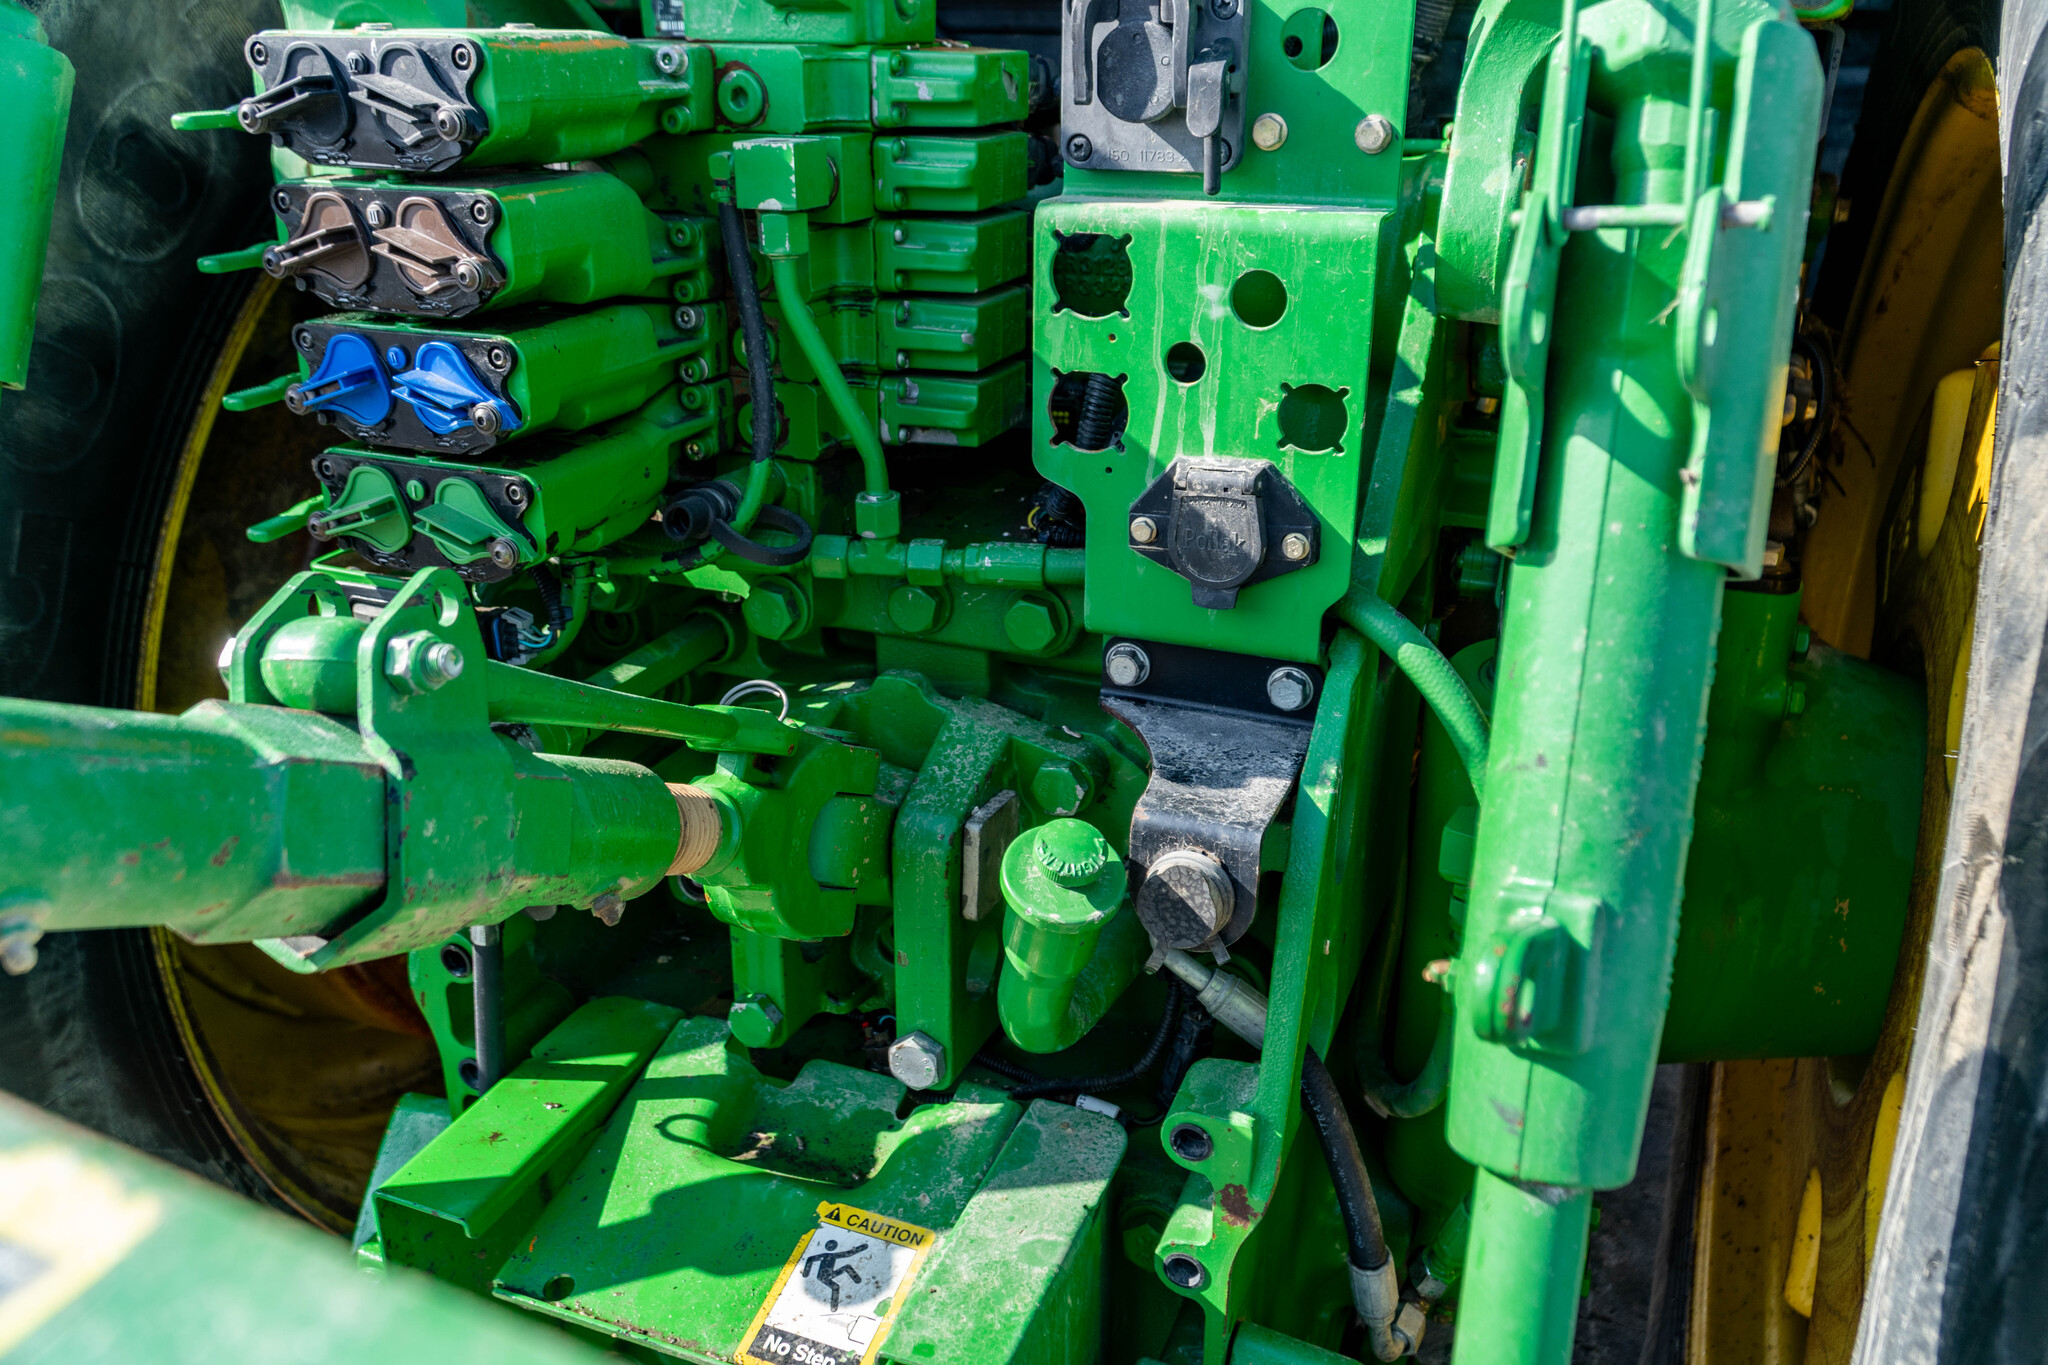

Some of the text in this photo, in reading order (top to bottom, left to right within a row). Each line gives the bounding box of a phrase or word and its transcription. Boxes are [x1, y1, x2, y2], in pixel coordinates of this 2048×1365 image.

[1108, 149, 1188, 163] ISO 11783-2
[1182, 527, 1248, 555] Pollak
[846, 1214, 925, 1246] CAUTION
[762, 1333, 791, 1356] No
